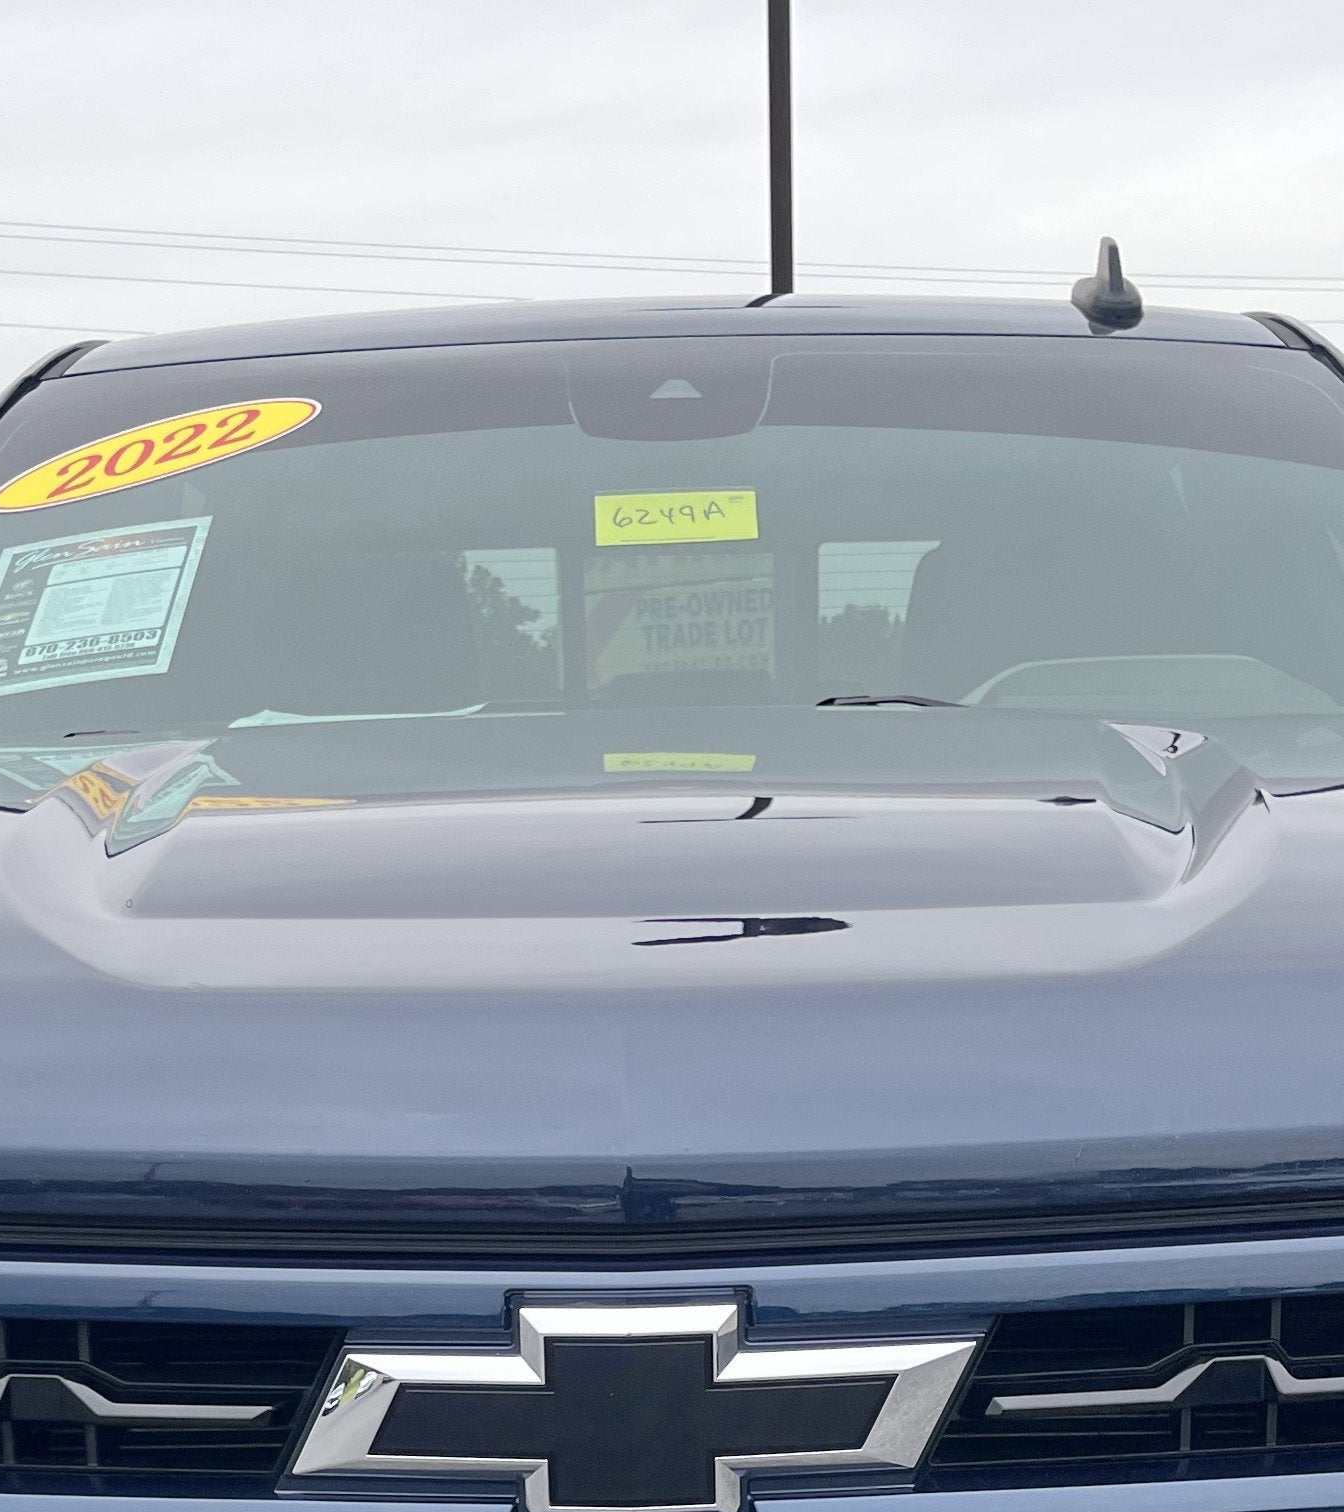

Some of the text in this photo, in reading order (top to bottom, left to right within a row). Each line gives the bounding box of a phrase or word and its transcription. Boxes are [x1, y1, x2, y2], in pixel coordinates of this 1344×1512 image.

[46, 409, 262, 499] 2022
[612, 500, 726, 528] 6249A
[636, 587, 774, 622] PRE-OWNED
[643, 616, 768, 653] TRADE LOT
